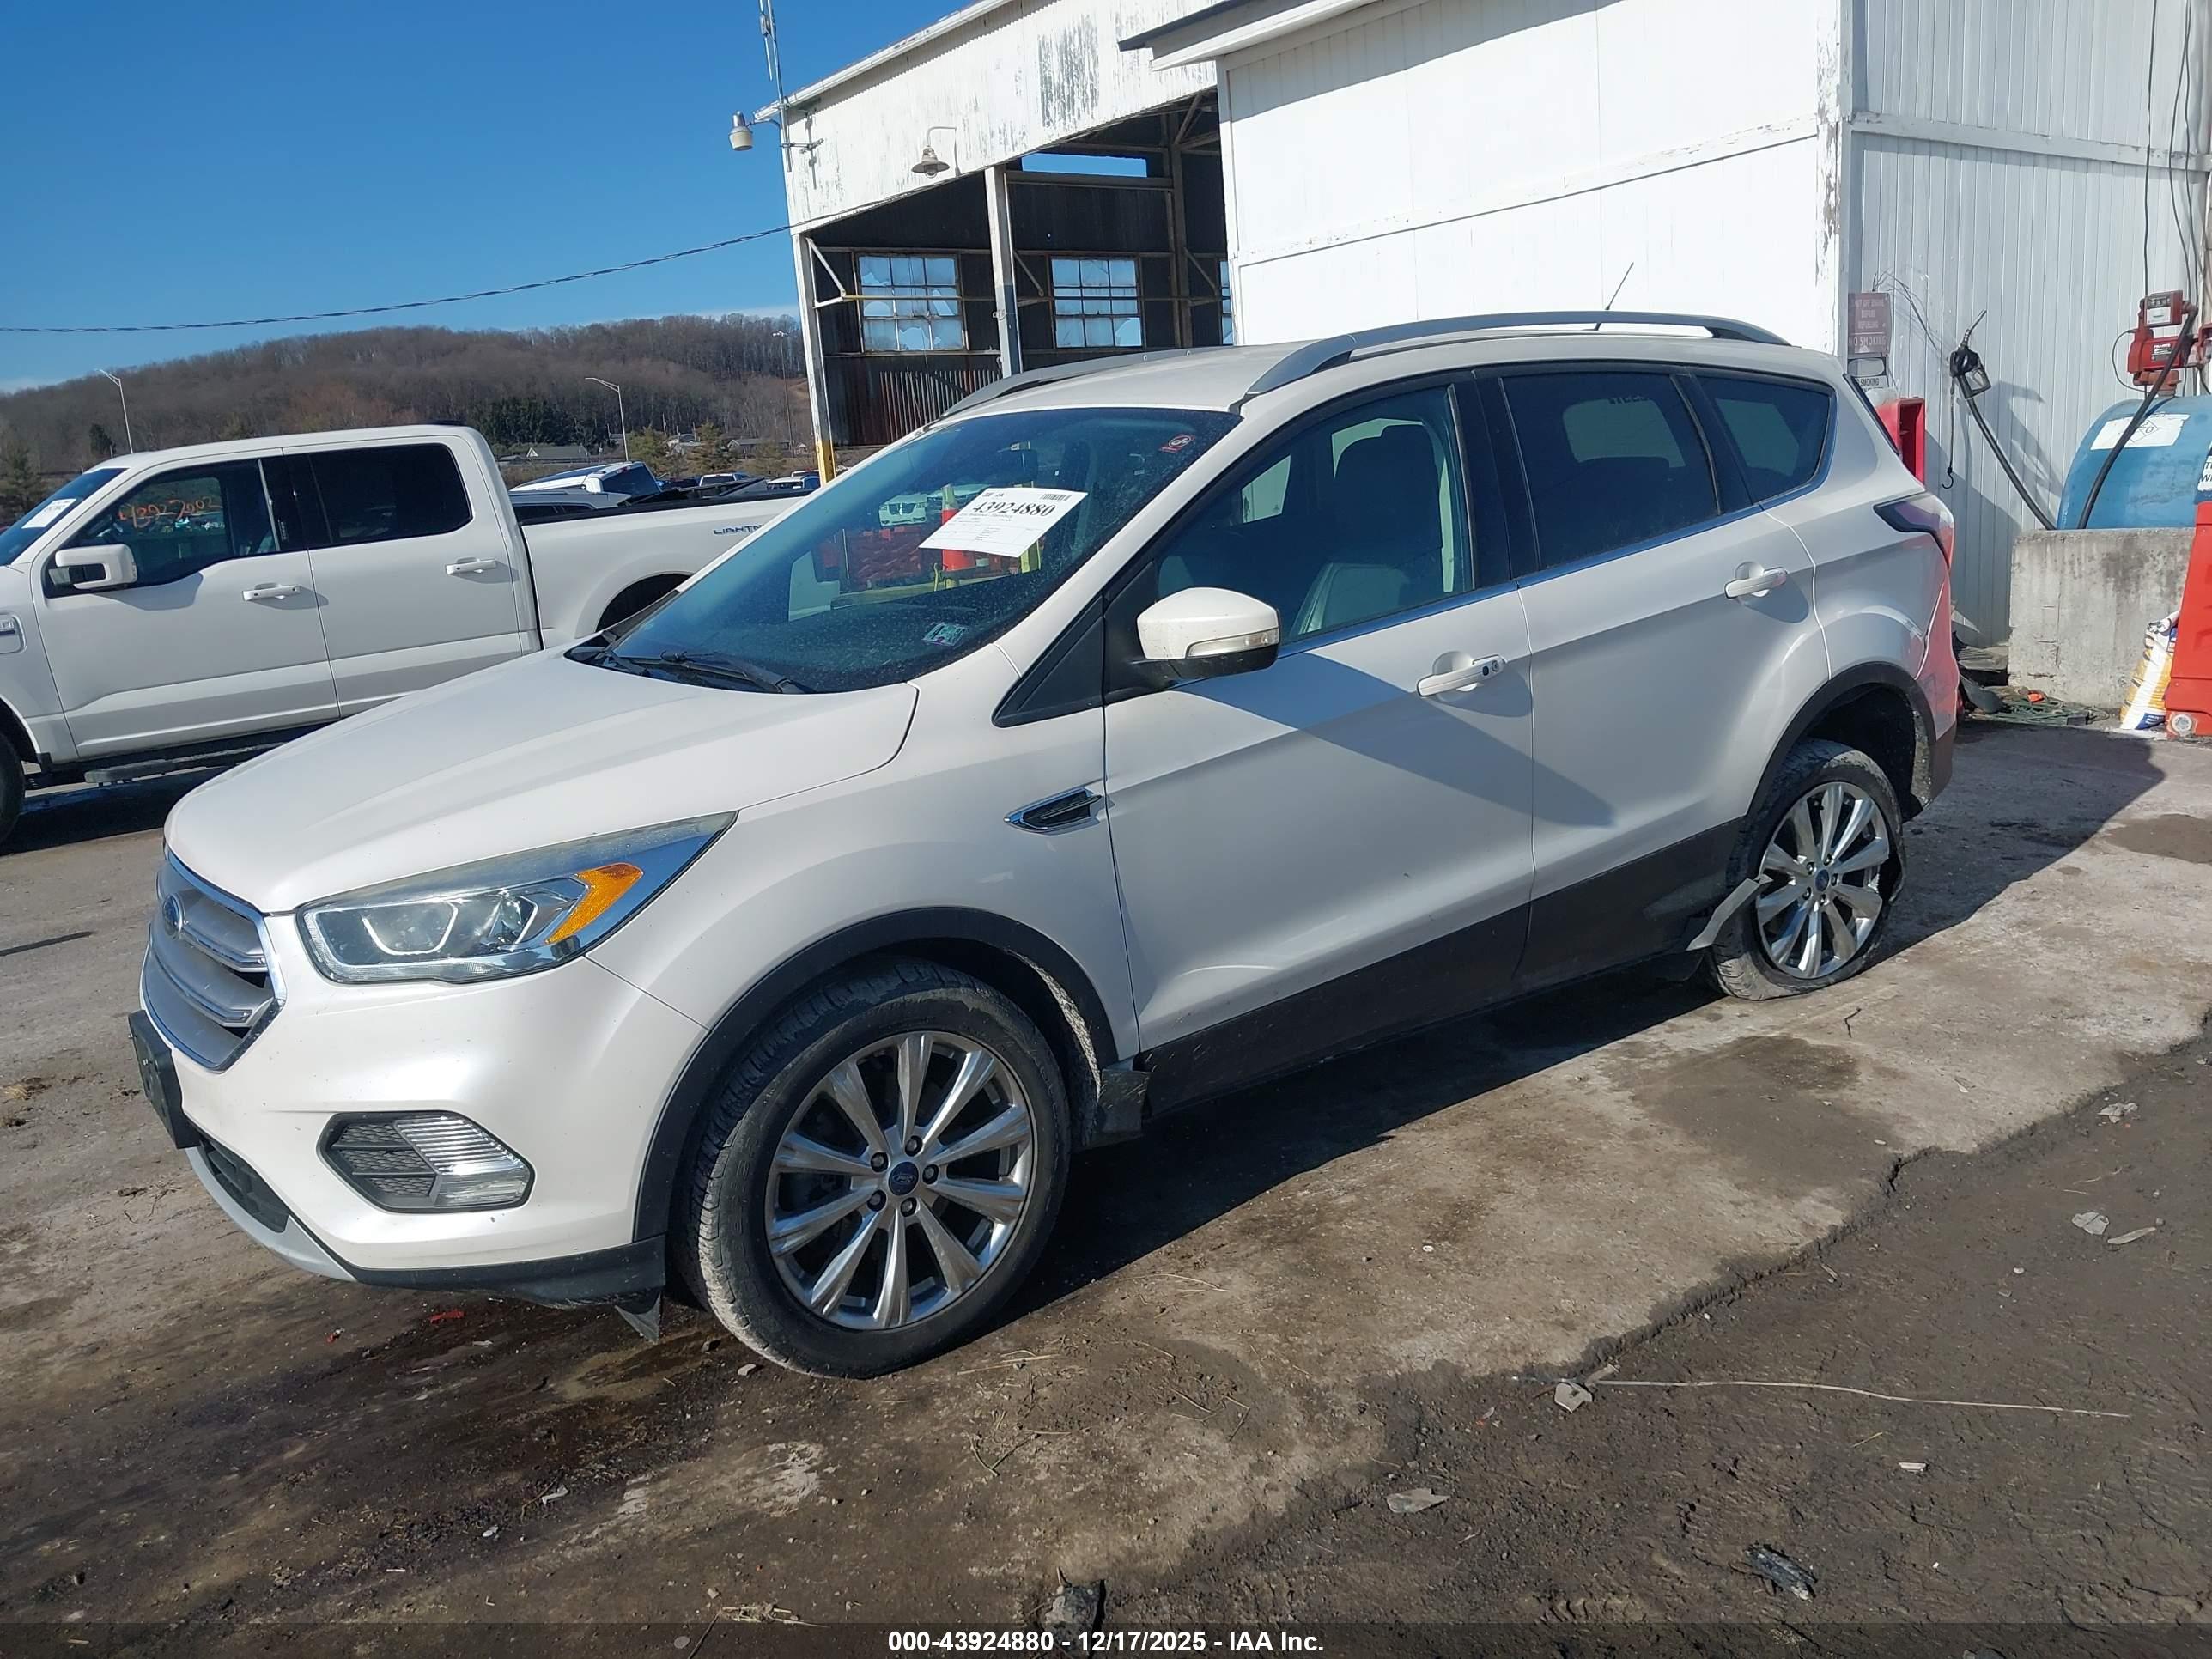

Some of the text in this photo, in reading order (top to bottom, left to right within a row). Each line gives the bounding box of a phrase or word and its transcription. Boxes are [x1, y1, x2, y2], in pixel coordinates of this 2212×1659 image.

[1860, 336, 1887, 346] SMOKING
[1860, 378, 1880, 386] SMOKING
[973, 501, 1057, 517] 43924880
